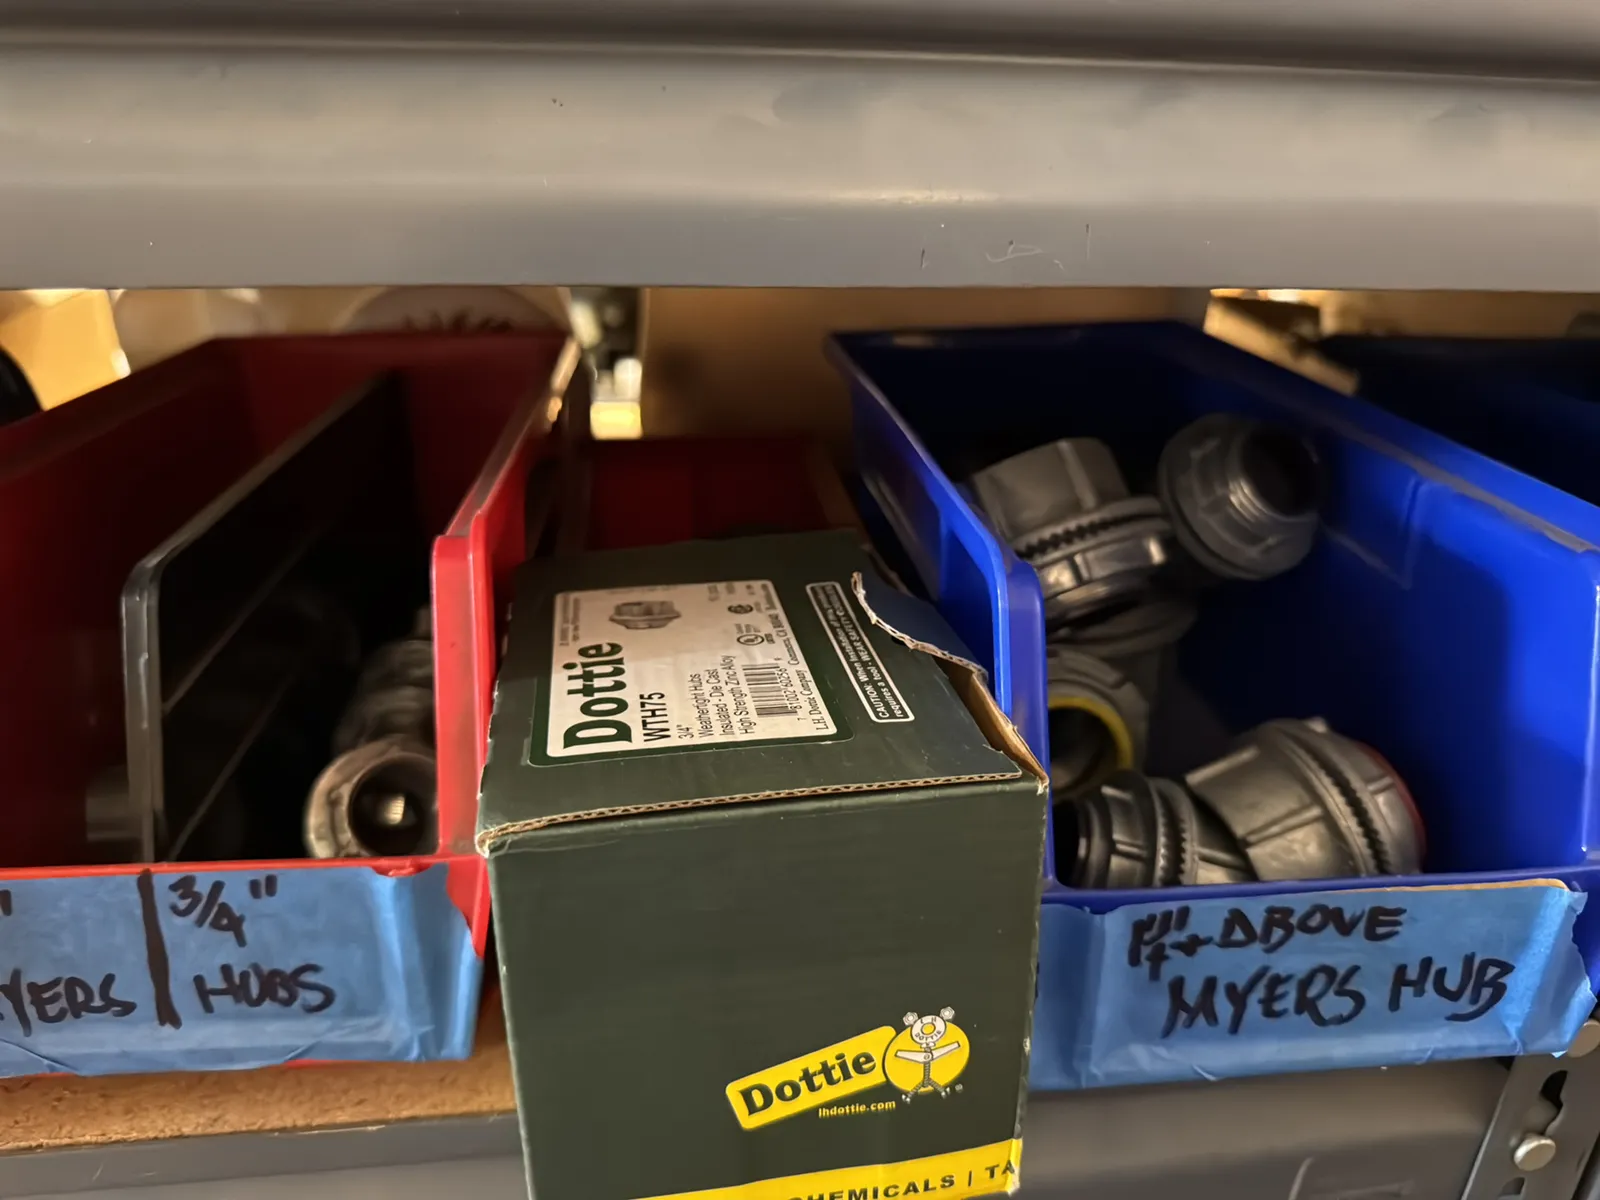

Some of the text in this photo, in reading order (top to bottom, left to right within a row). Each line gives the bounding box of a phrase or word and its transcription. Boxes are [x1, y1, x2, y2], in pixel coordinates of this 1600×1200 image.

[854, 640, 871, 663] WEAR
[706, 668, 721, 688] Cast
[795, 669, 814, 698] Company
[854, 662, 869, 682] When
[870, 665, 882, 681] tool
[562, 642, 633, 749] Dottie
[690, 673, 714, 738] Weathertight Hubs
[709, 687, 725, 699] Die
[720, 655, 756, 735] High Strength Zinc Alloy
[804, 699, 823, 719] Dottie
[864, 682, 889, 718] CAUTION:
[880, 686, 904, 718] requires
[639, 692, 671, 742] WTH75
[678, 724, 694, 740] 3/4"
[712, 703, 735, 736] Insulated
[814, 717, 830, 731] L.H.
[168, 874, 277, 948] 3/4"
[1216, 904, 1406, 954] ABOVE
[0, 967, 138, 1038] YERS
[192, 962, 336, 1014] HUBS
[1161, 951, 1515, 1040] MYERS HUB
[914, 1029, 943, 1042] DOTTIE
[738, 1051, 877, 1116] Dottie
[818, 1100, 896, 1119] lhdottie.com
[787, 1174, 955, 1200] HEMICALS
